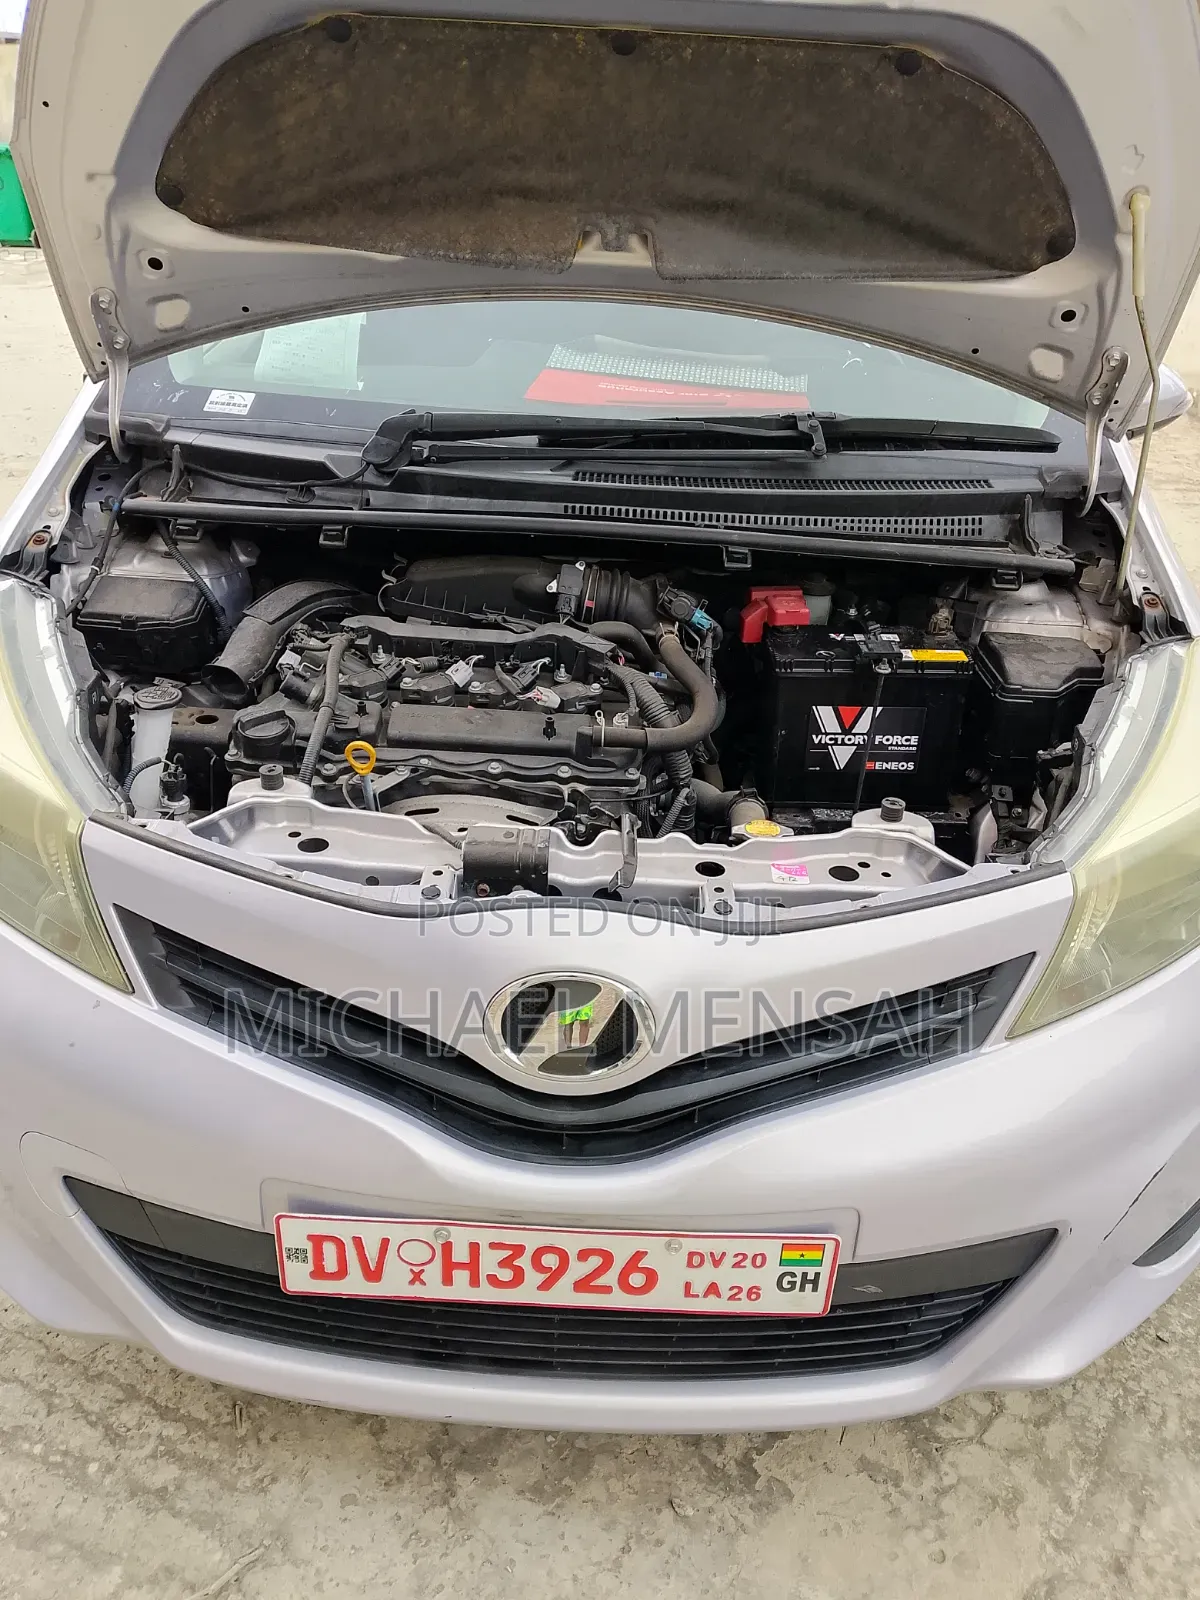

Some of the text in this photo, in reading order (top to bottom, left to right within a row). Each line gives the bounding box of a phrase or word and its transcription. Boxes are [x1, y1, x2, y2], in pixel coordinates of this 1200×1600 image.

[874, 735, 919, 745] FORCE
[874, 761, 915, 770] ENEOS
[306, 1234, 659, 1297] DV H3926
[775, 1271, 821, 1293] GH
